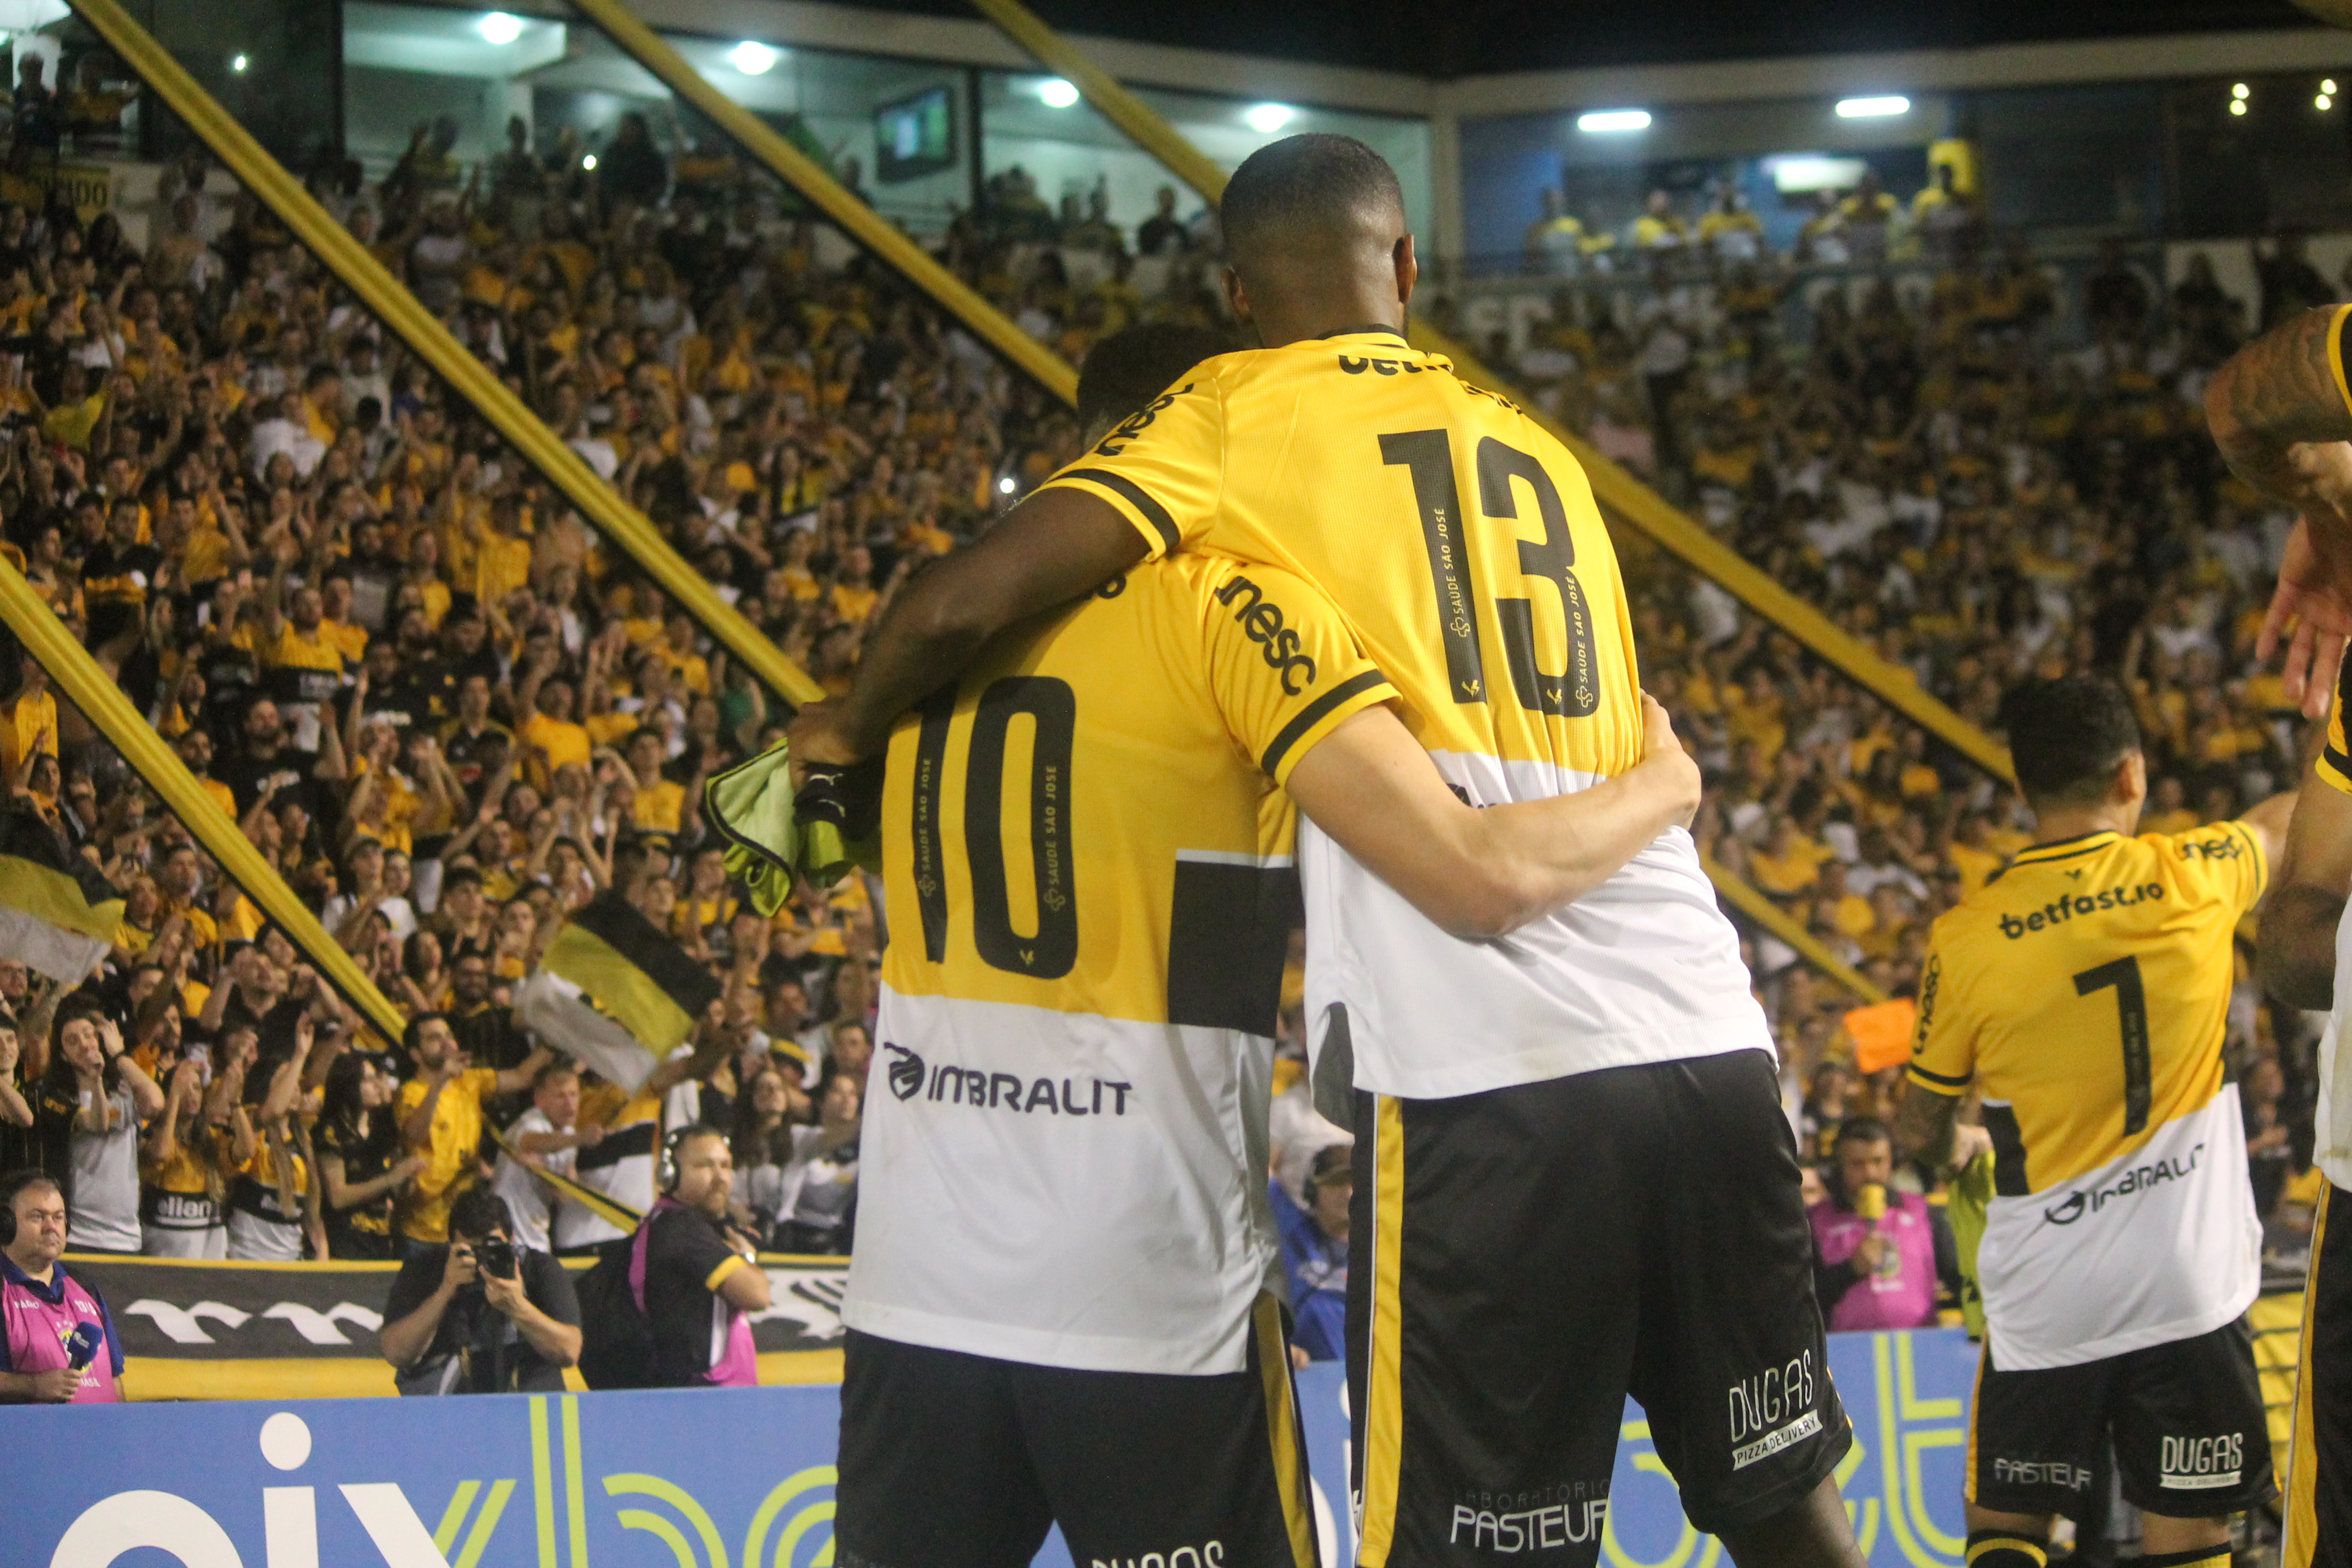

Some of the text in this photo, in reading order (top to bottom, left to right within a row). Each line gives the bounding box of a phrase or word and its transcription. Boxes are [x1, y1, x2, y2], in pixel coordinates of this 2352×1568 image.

[1378, 429, 1600, 717] 13
[912, 676, 1078, 979] 10
[1999, 883, 2164, 940] betfast.io
[2072, 955, 2153, 1137] 7
[1729, 1349, 1813, 1443] DUGAS
[1737, 1416, 1817, 1464] PIZZA DELIVERY
[2162, 1432, 2243, 1474] DUGAS
